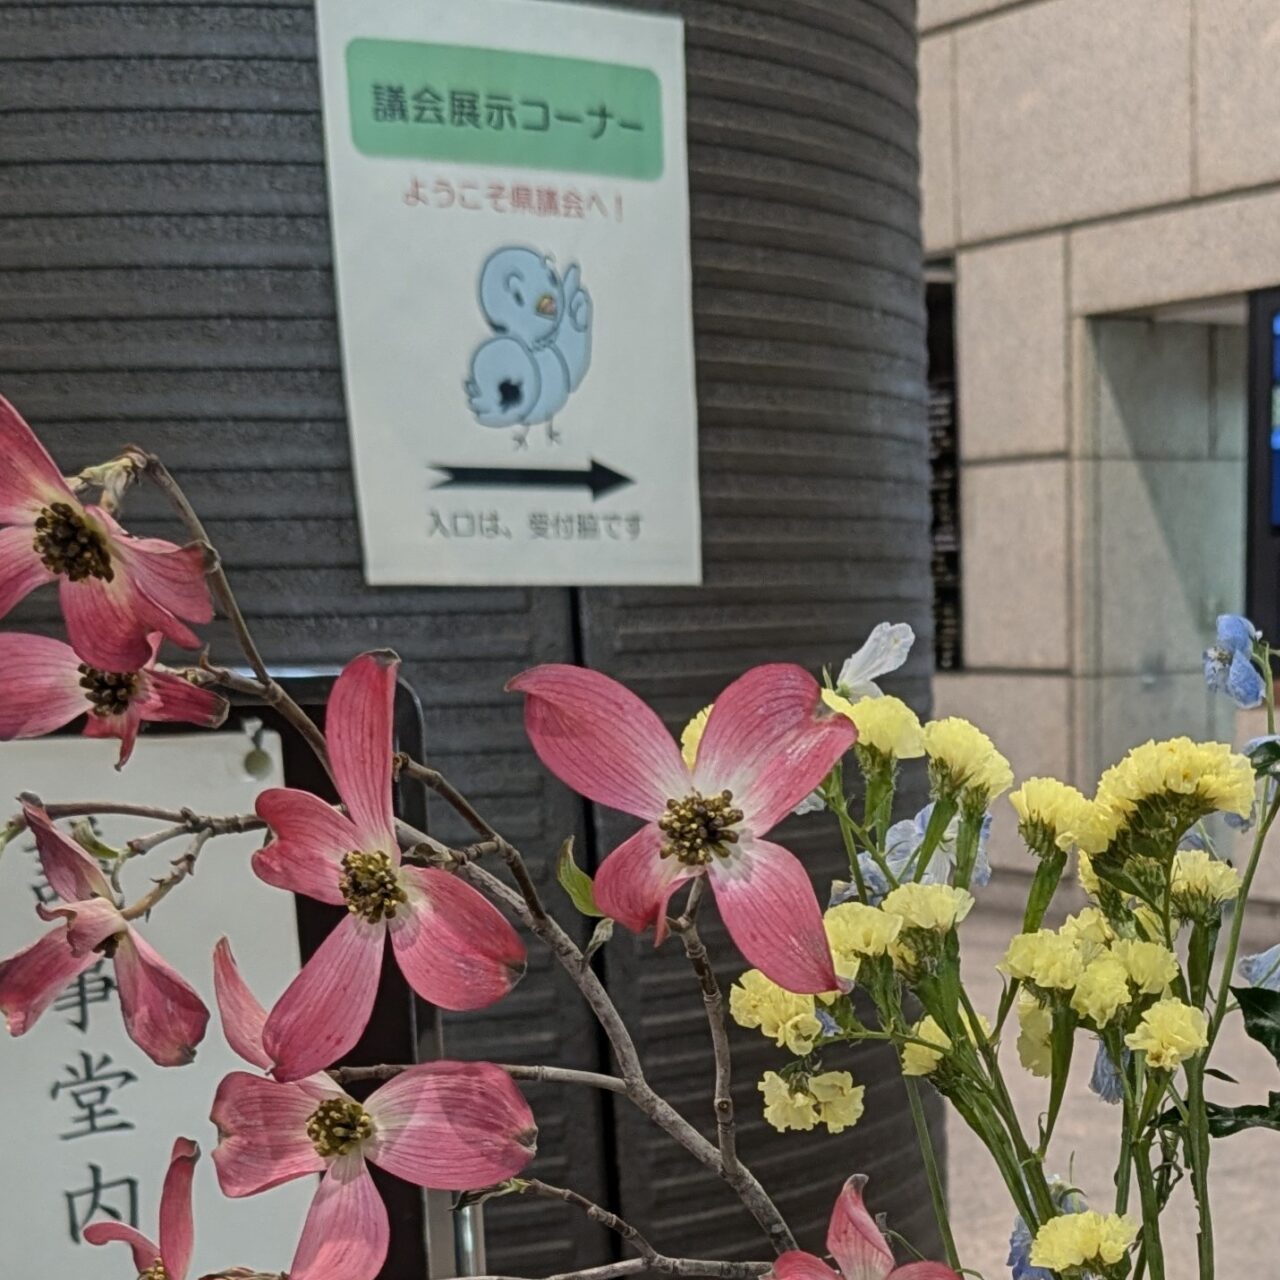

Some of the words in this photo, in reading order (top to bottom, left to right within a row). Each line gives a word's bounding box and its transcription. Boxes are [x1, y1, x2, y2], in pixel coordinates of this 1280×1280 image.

[371, 83, 645, 140] 議会展示コーナー
